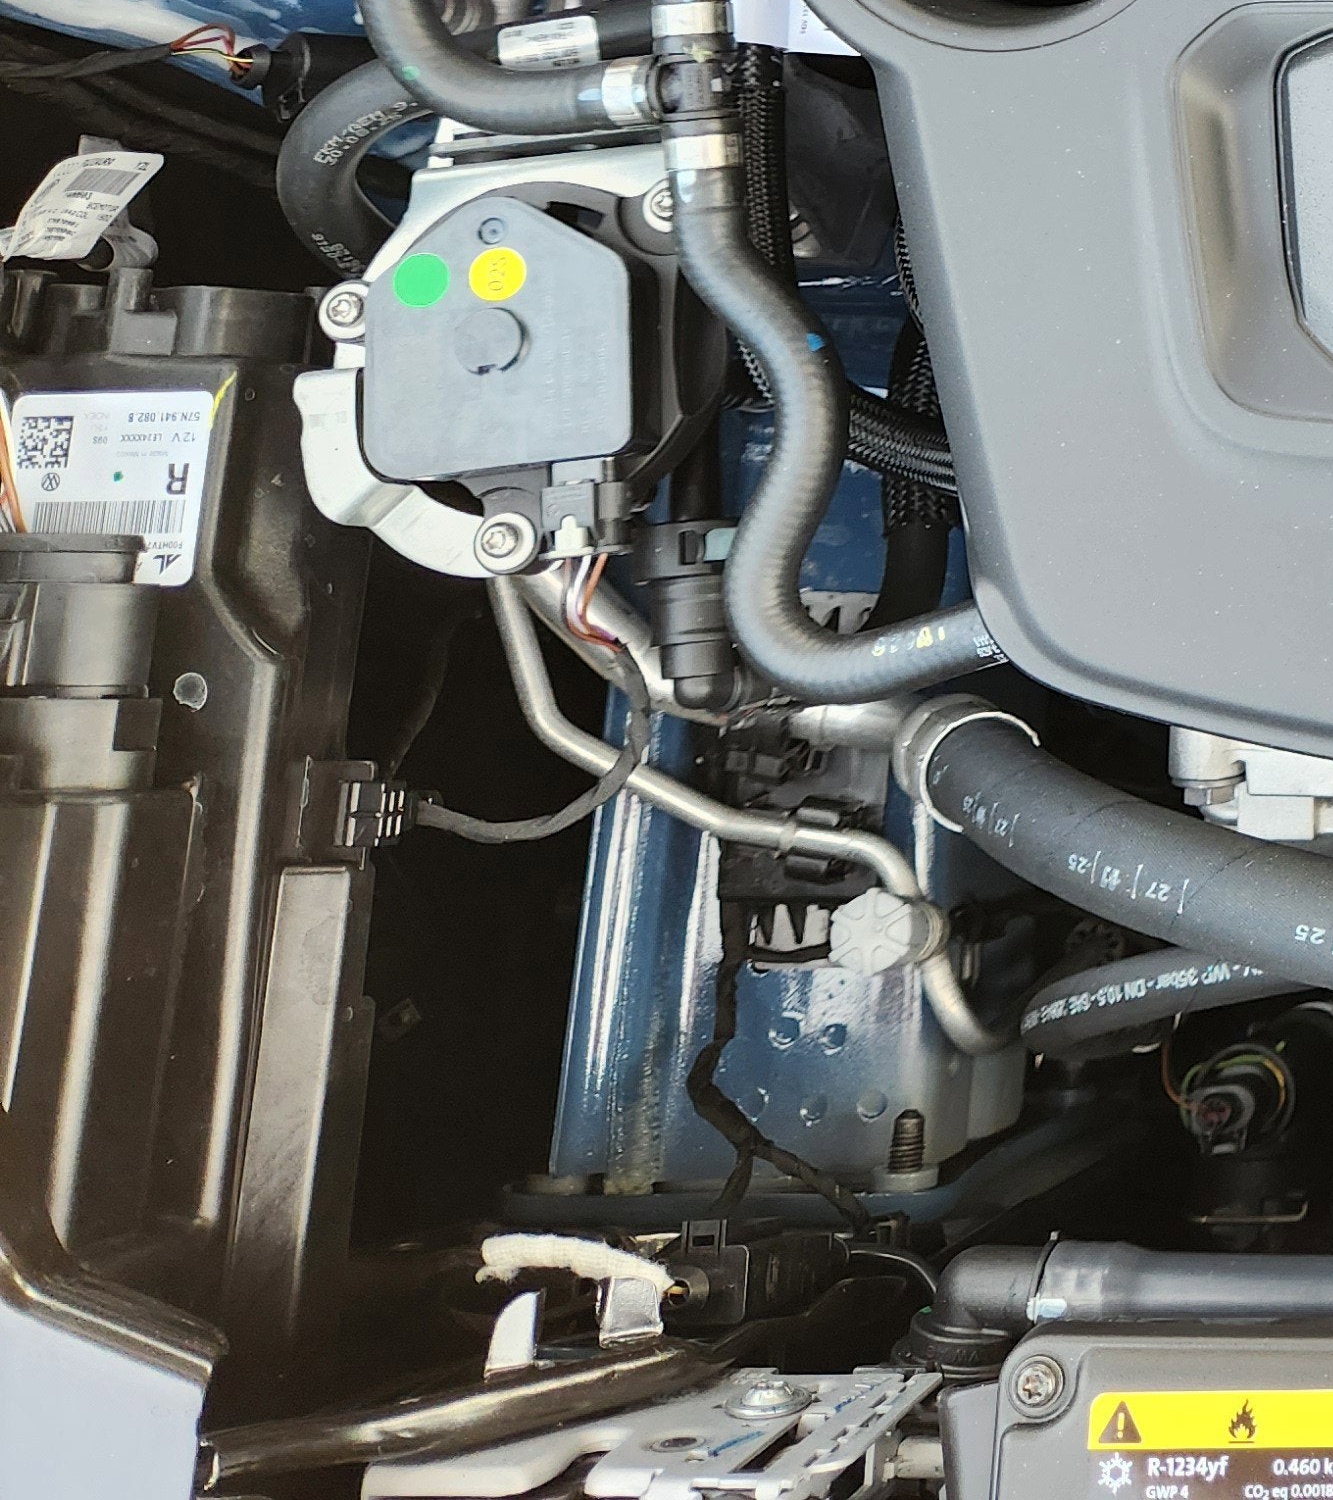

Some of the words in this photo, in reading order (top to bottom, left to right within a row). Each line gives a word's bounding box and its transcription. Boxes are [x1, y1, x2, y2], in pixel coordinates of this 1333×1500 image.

[165, 462, 190, 496] R
[1294, 923, 1324, 944] 25
[1147, 1455, 1229, 1482] R-1234yf
[1272, 1458, 1322, 1477] 0.460
[1146, 1485, 1178, 1499] GWP
[1180, 1485, 1189, 1499] 4
[1291, 1484, 1333, 1499] 0.0018
